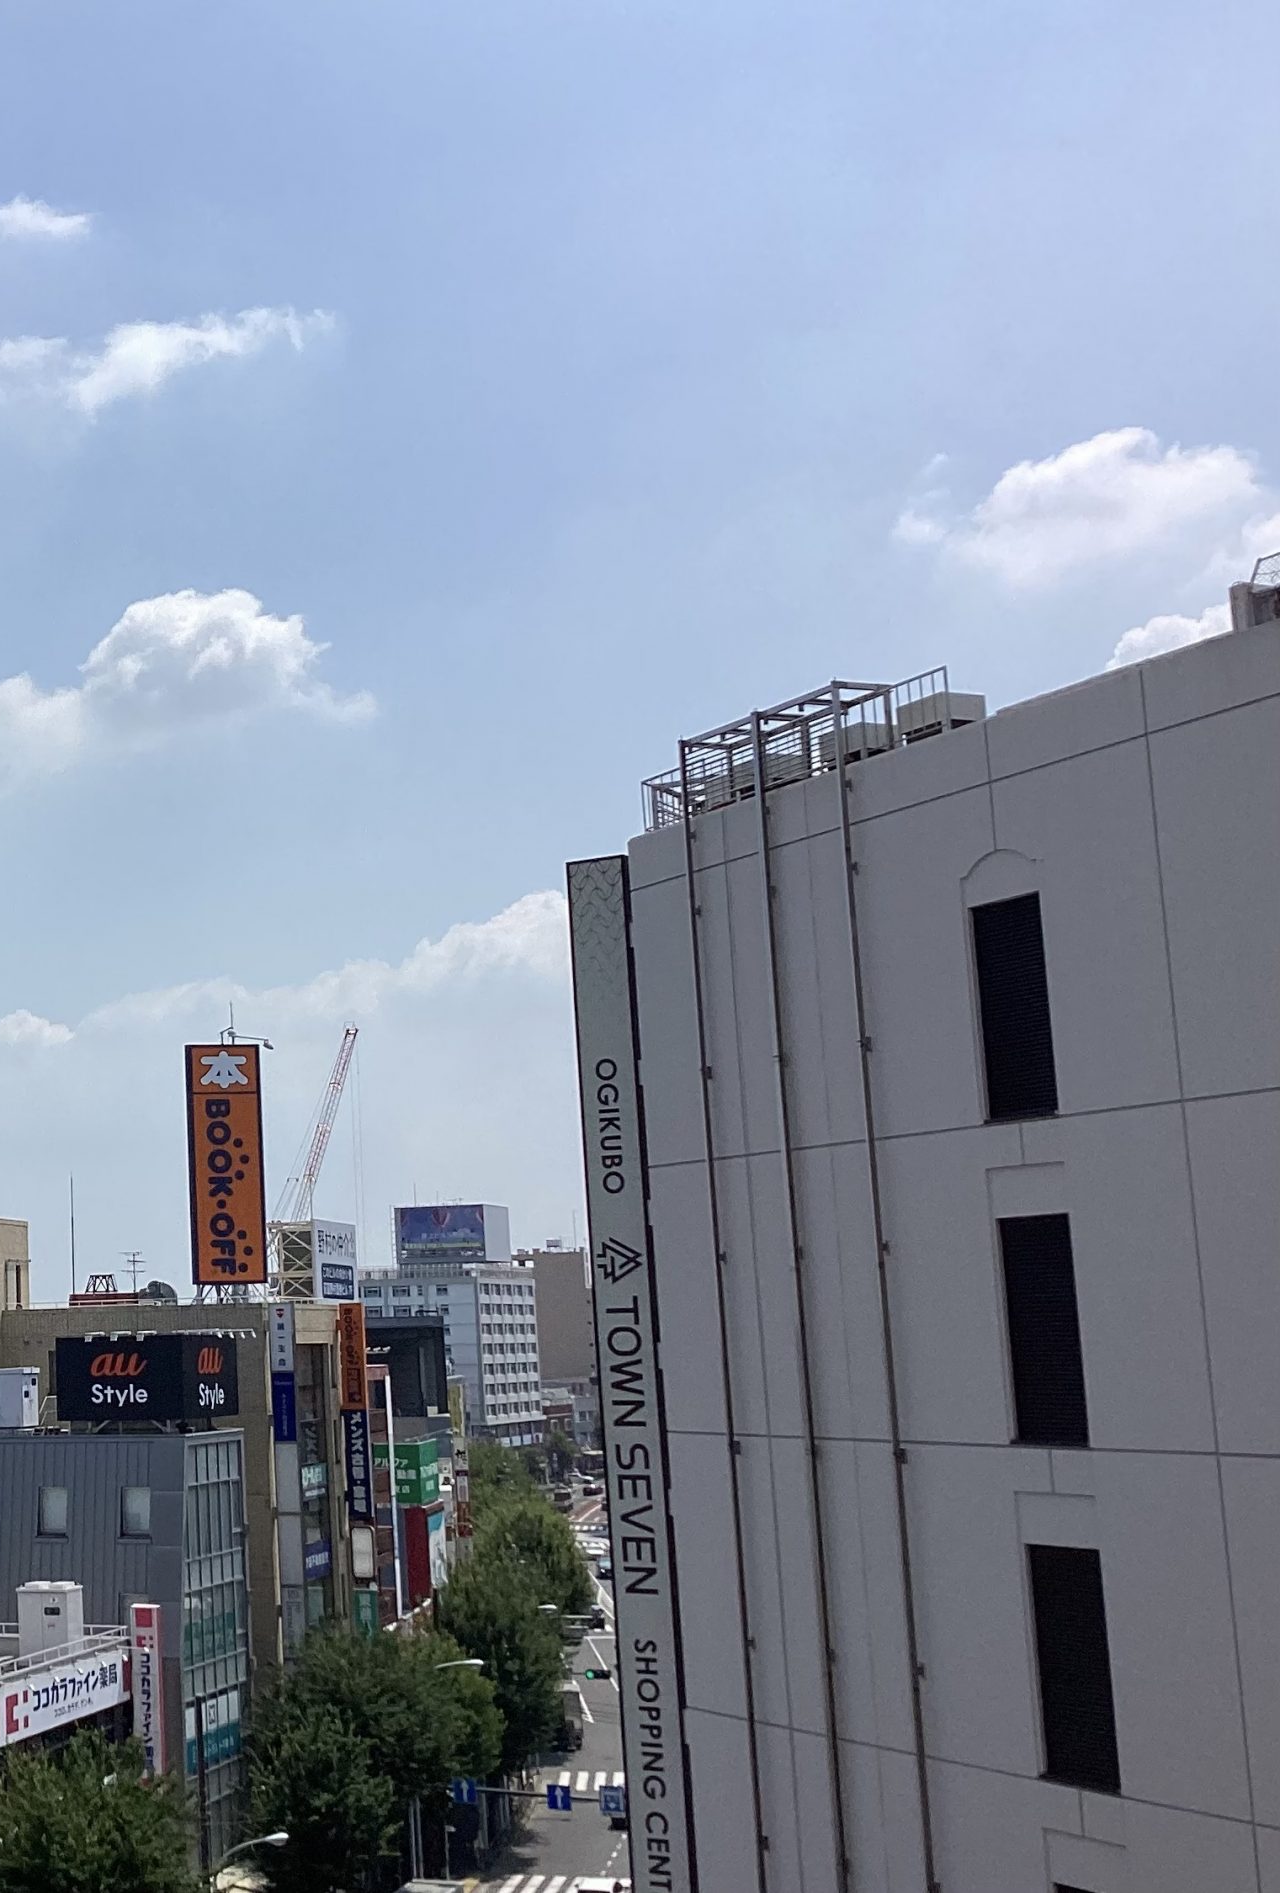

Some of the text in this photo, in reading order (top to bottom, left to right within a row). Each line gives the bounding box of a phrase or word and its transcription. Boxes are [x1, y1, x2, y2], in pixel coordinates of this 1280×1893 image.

[200, 1051, 249, 1088] 本
[90, 1352, 147, 1377] au
[197, 1347, 223, 1375] au
[91, 1383, 148, 1407] Style
[198, 1382, 225, 1410] Style
[595, 1058, 673, 1893] OGIKUBO TOWN SEVEN SHOPPING CENT
[33, 1663, 118, 1712] ココカラファイン薬局
